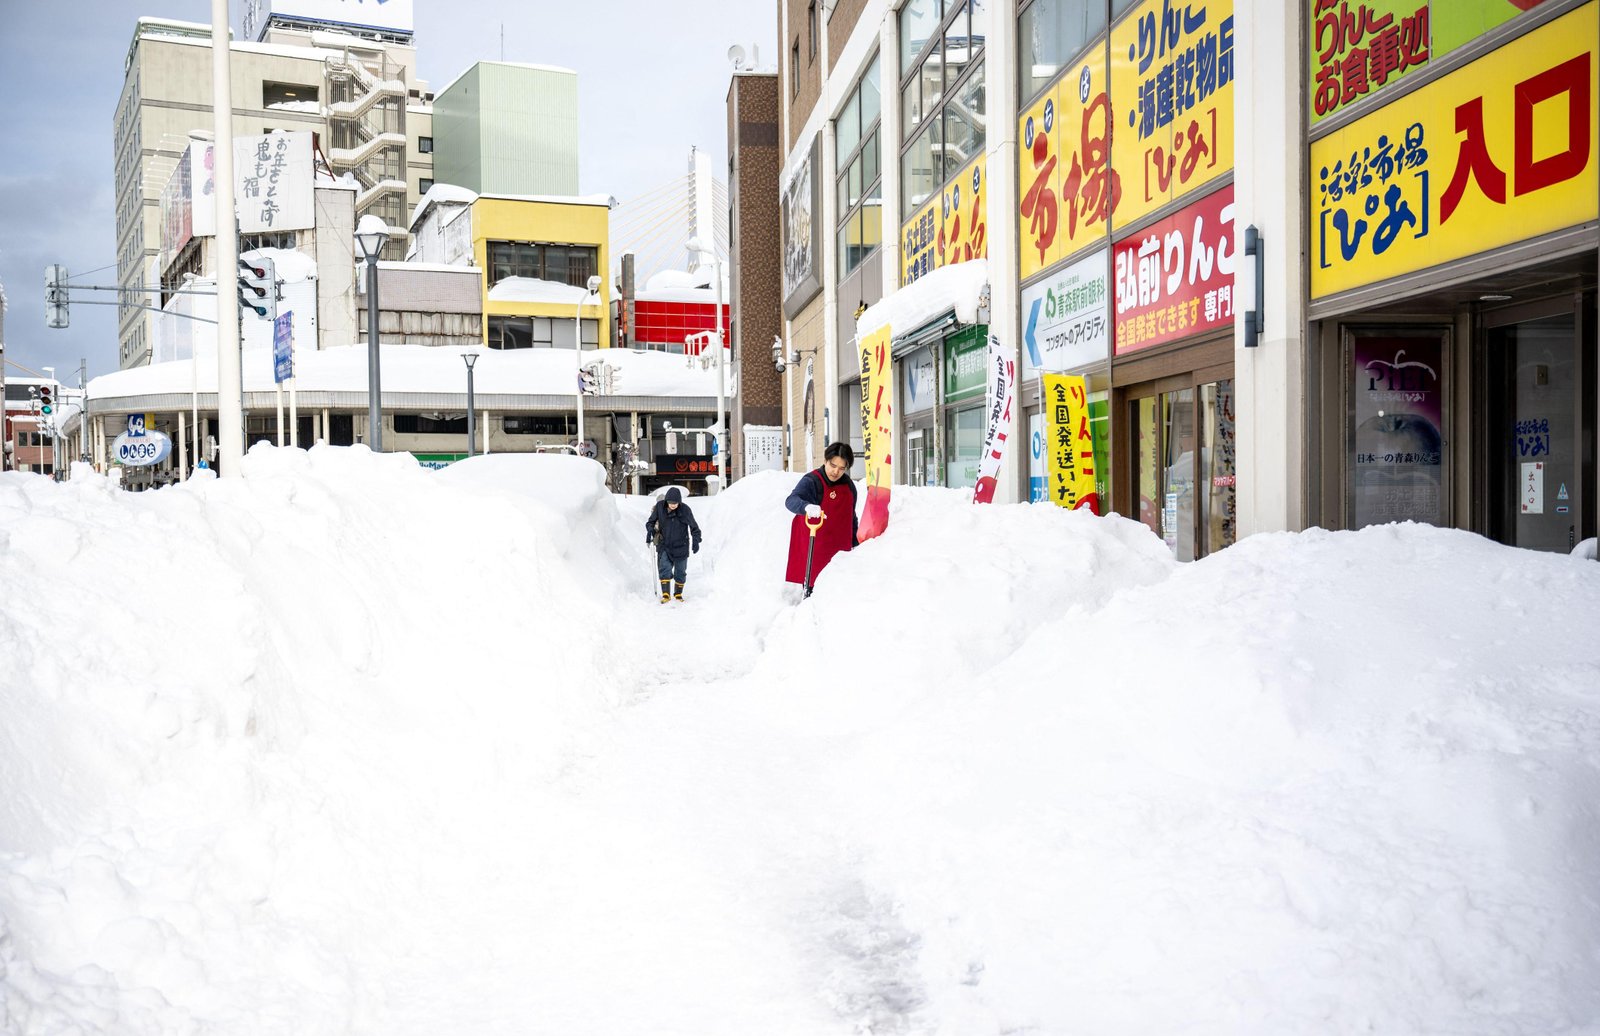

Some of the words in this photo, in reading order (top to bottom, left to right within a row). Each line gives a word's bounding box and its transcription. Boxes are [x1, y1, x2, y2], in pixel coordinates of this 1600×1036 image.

[1314, 4, 1429, 116] お食事処
[1439, 50, 1591, 227] 入口
[1319, 122, 1429, 207] 活彩市場
[1057, 274, 1105, 319] 青森駅前眼科
[1204, 284, 1236, 322] 専門
[1045, 315, 1106, 352] コンタクトのアイシティ
[1116, 296, 1200, 348] 全国発送できます
[120, 443, 156, 460] しんまち
[1053, 383, 1076, 509] 全国発送いた
[1527, 471, 1536, 504] 出入口
